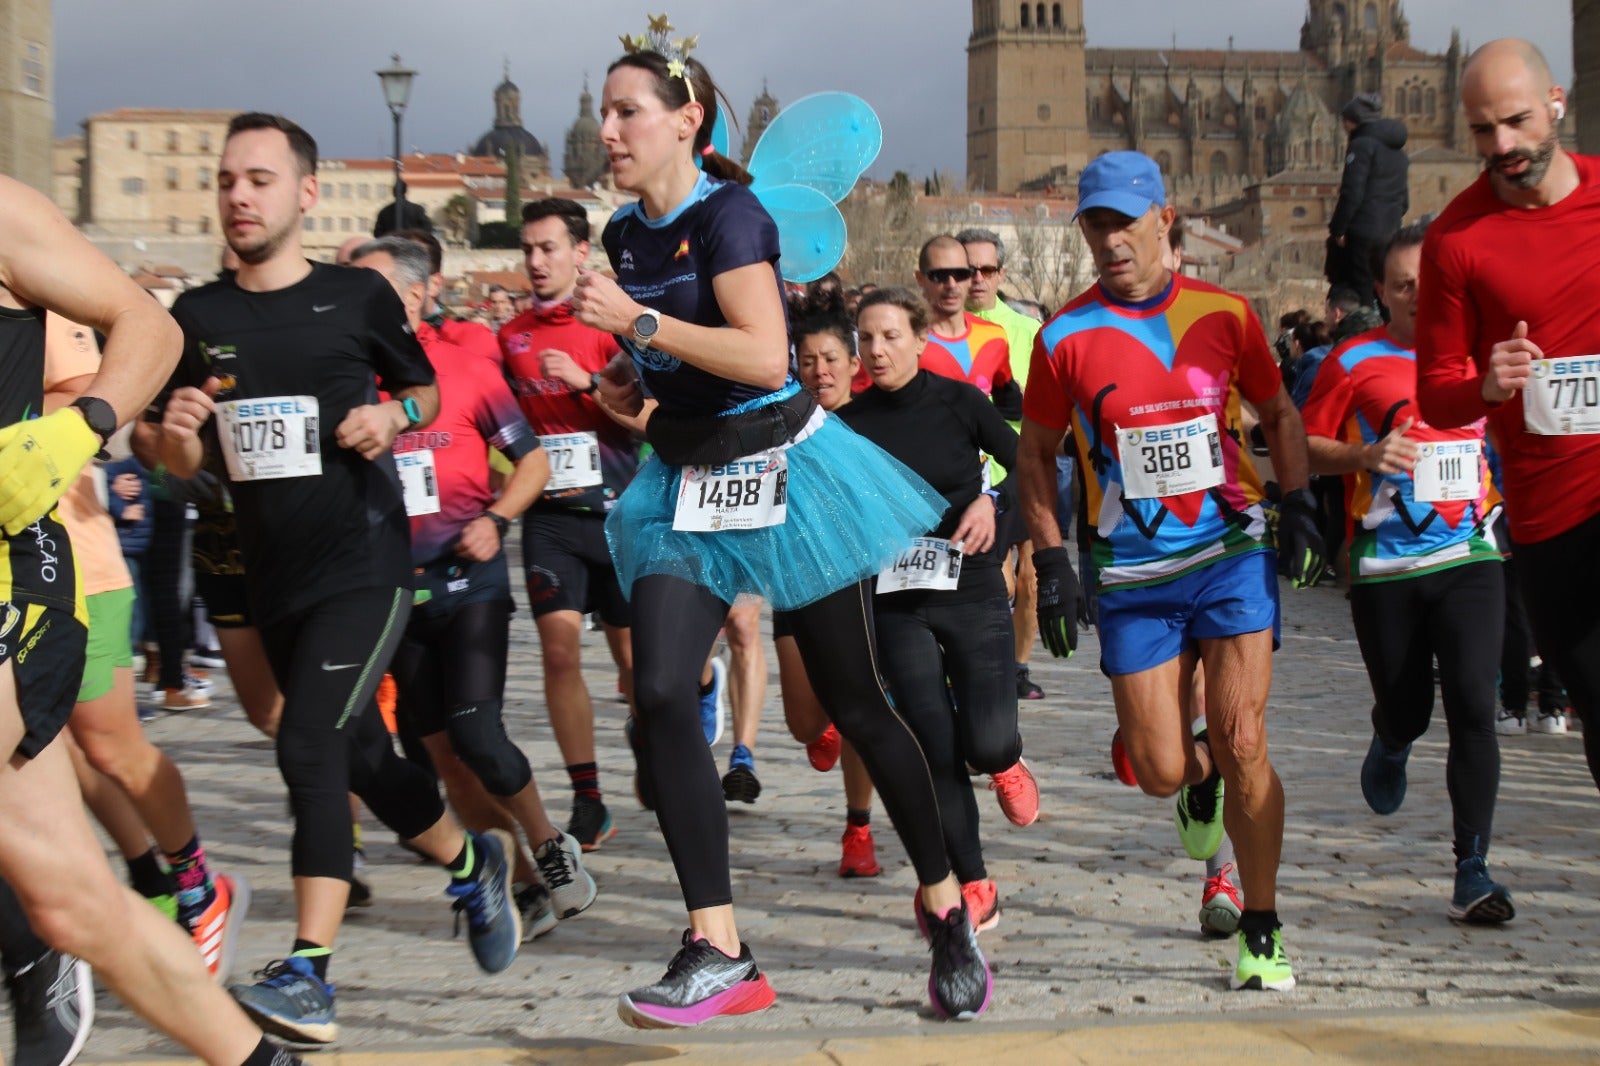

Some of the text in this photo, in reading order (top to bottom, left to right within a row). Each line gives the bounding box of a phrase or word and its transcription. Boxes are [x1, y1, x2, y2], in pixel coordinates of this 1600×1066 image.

[1553, 360, 1600, 375] SET
[1548, 377, 1598, 409] 770
[238, 402, 307, 418] SETEL
[1129, 405, 1145, 416] SAN
[1145, 400, 1181, 413] SILVESTRE
[232, 419, 286, 453] 1078
[544, 436, 589, 448] SETEL
[1145, 422, 1208, 443] SETEL
[551, 448, 574, 470] 72
[1141, 441, 1191, 474] 368
[1436, 444, 1477, 455] SETEL
[1439, 457, 1461, 481] 1111
[698, 478, 761, 508] 1498
[914, 538, 951, 552] ETEL
[892, 549, 937, 572] 1448
